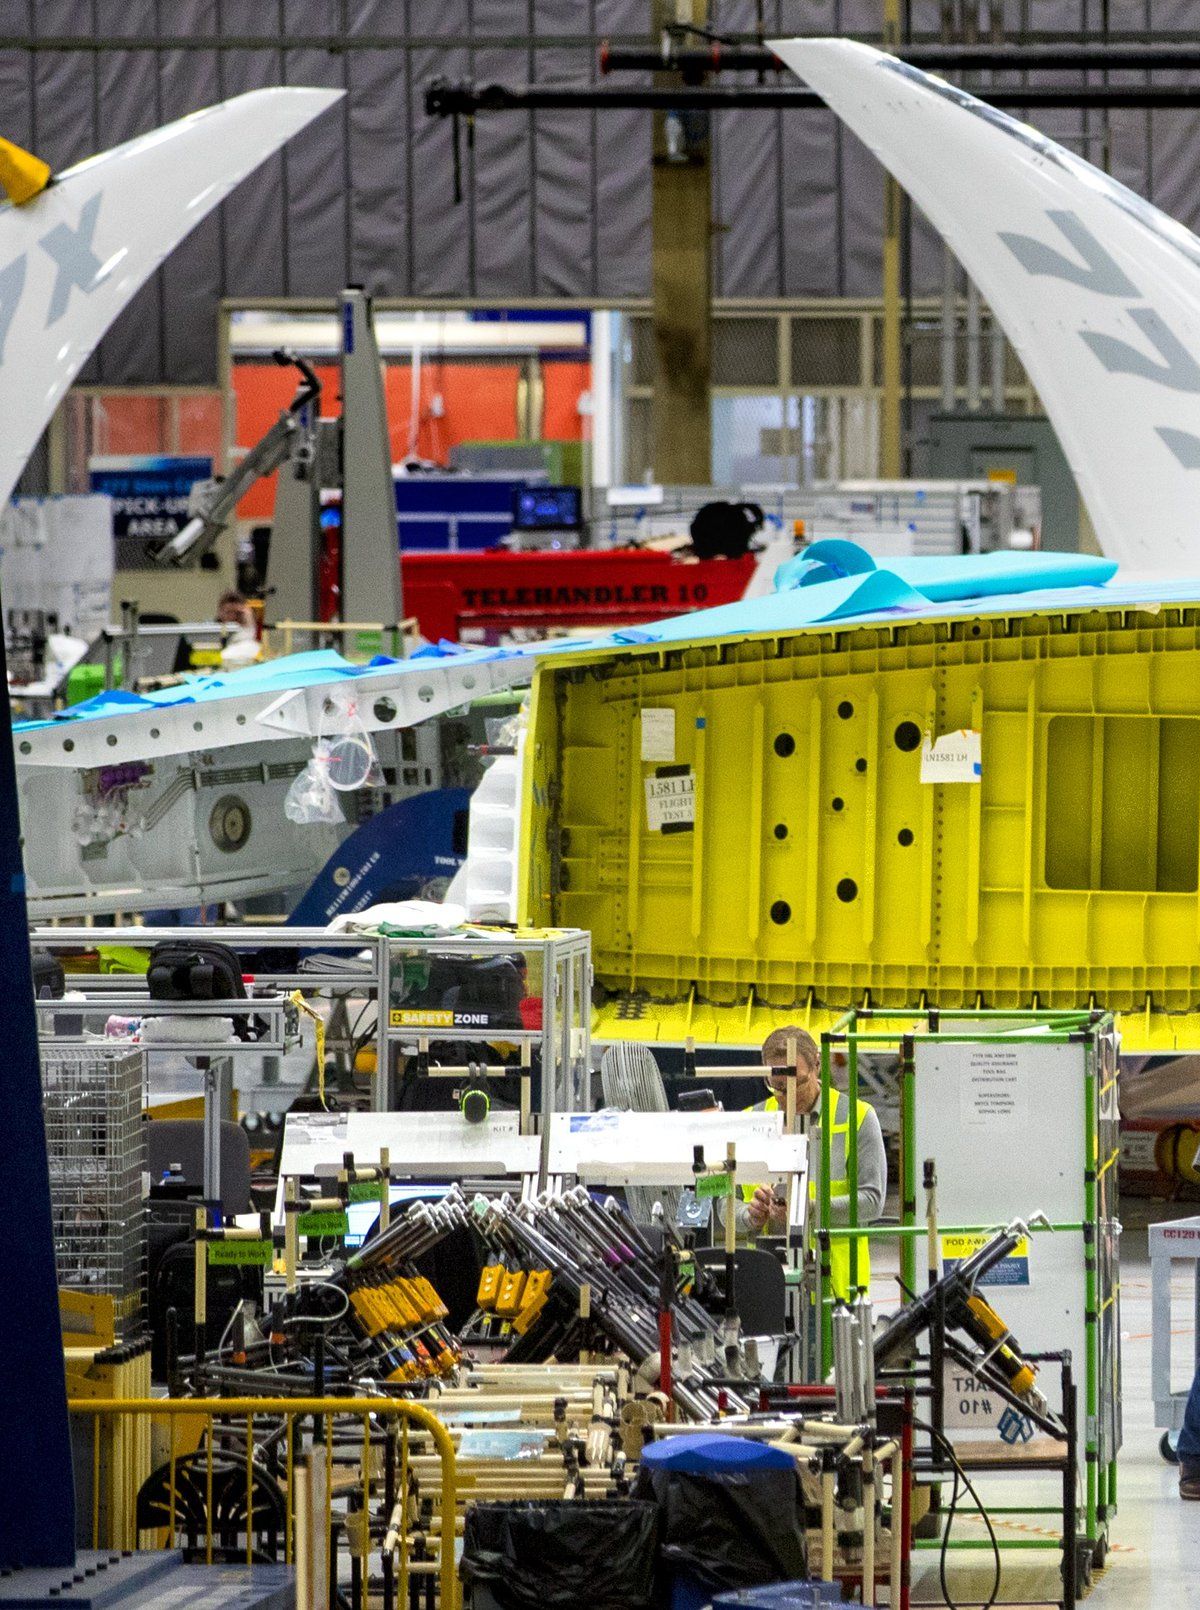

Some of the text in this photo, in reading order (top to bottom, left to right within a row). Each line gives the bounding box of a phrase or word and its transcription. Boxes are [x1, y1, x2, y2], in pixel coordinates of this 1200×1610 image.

[127, 518, 179, 537] AREA
[462, 582, 709, 607] TELEHANDLER 10
[925, 752, 968, 762] LN1581 LH
[650, 782, 675, 797] 1581
[402, 1012, 489, 1025] SAFETY ZONE
[493, 1125, 506, 1133] KIT
[946, 1238, 965, 1246] FOD
[215, 1249, 266, 1260] Ready to Work
